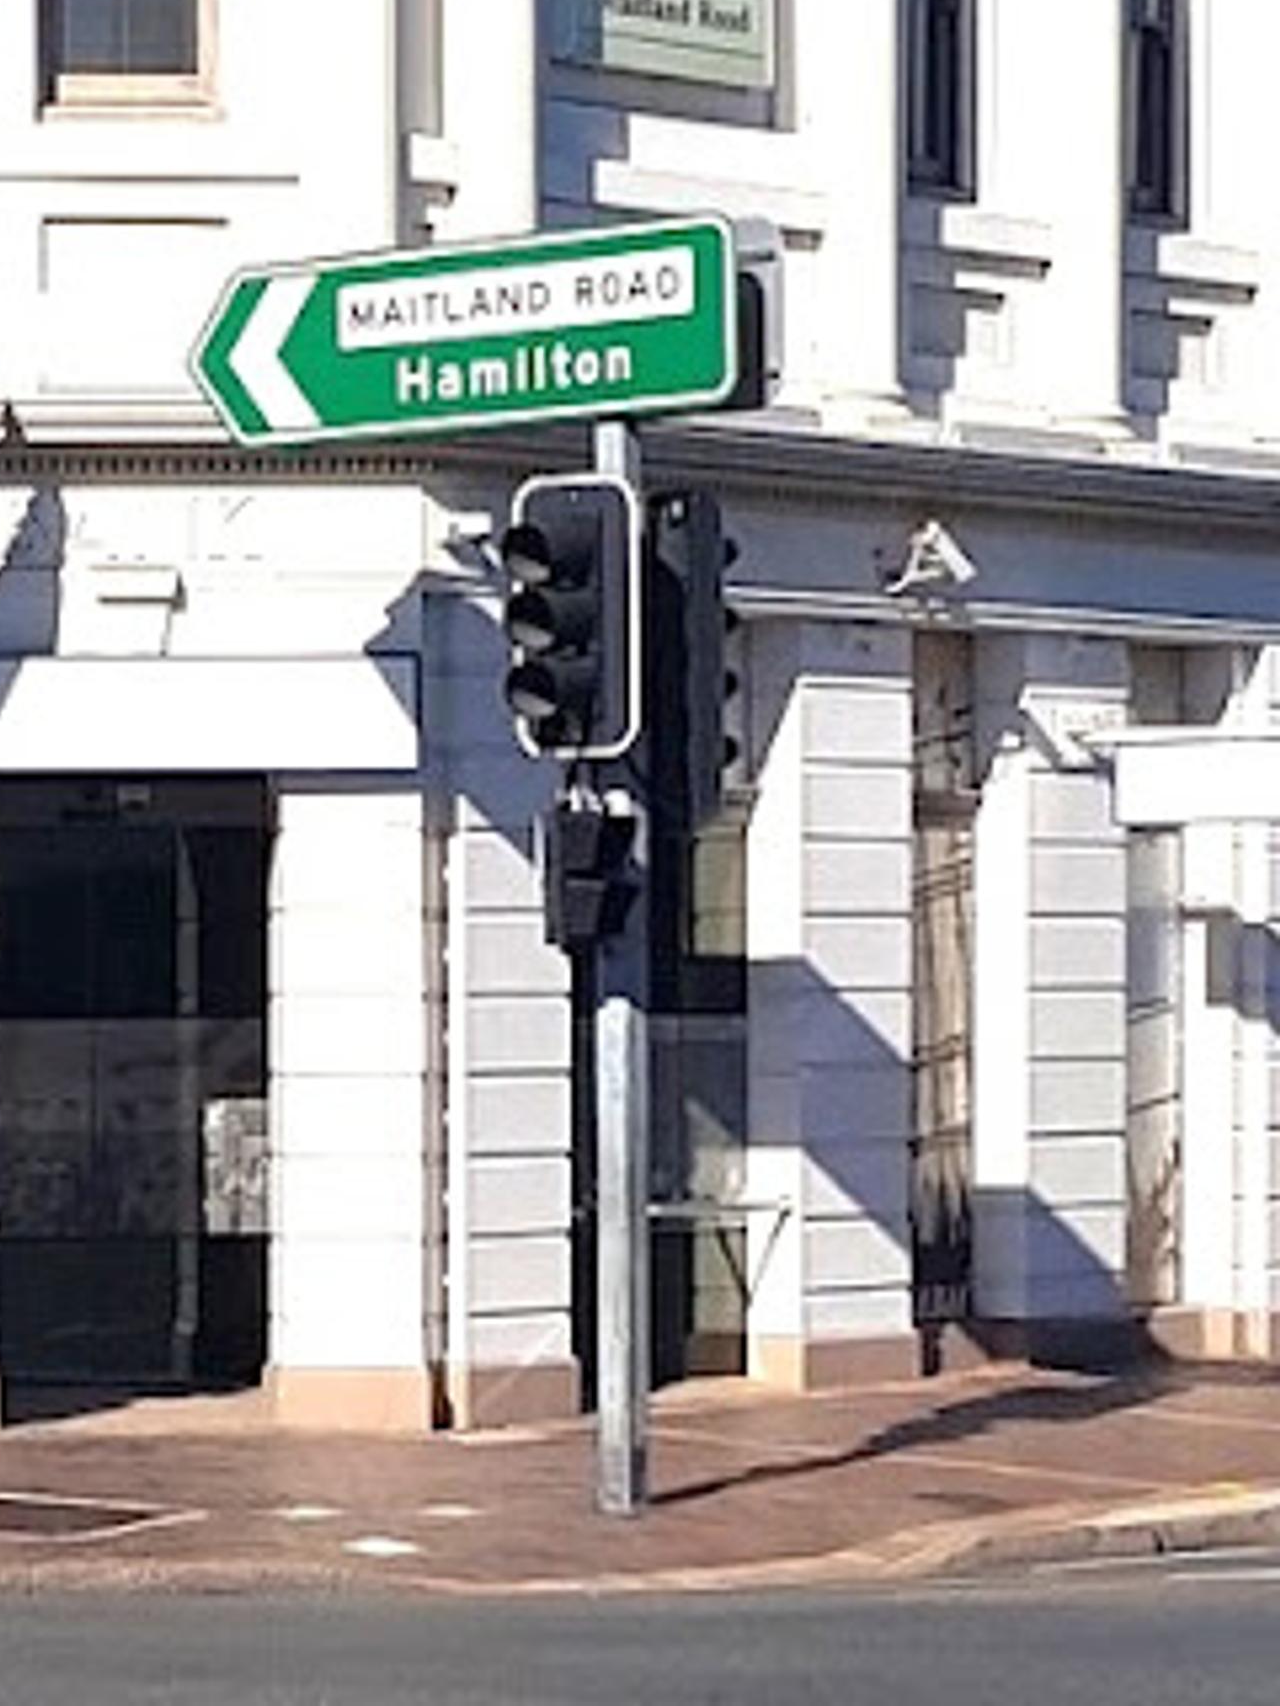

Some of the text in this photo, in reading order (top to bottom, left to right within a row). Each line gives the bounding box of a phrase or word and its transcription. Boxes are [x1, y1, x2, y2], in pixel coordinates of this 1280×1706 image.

[347, 267, 681, 331] MAITLAND ROAD
[395, 344, 633, 403] Hamilton
